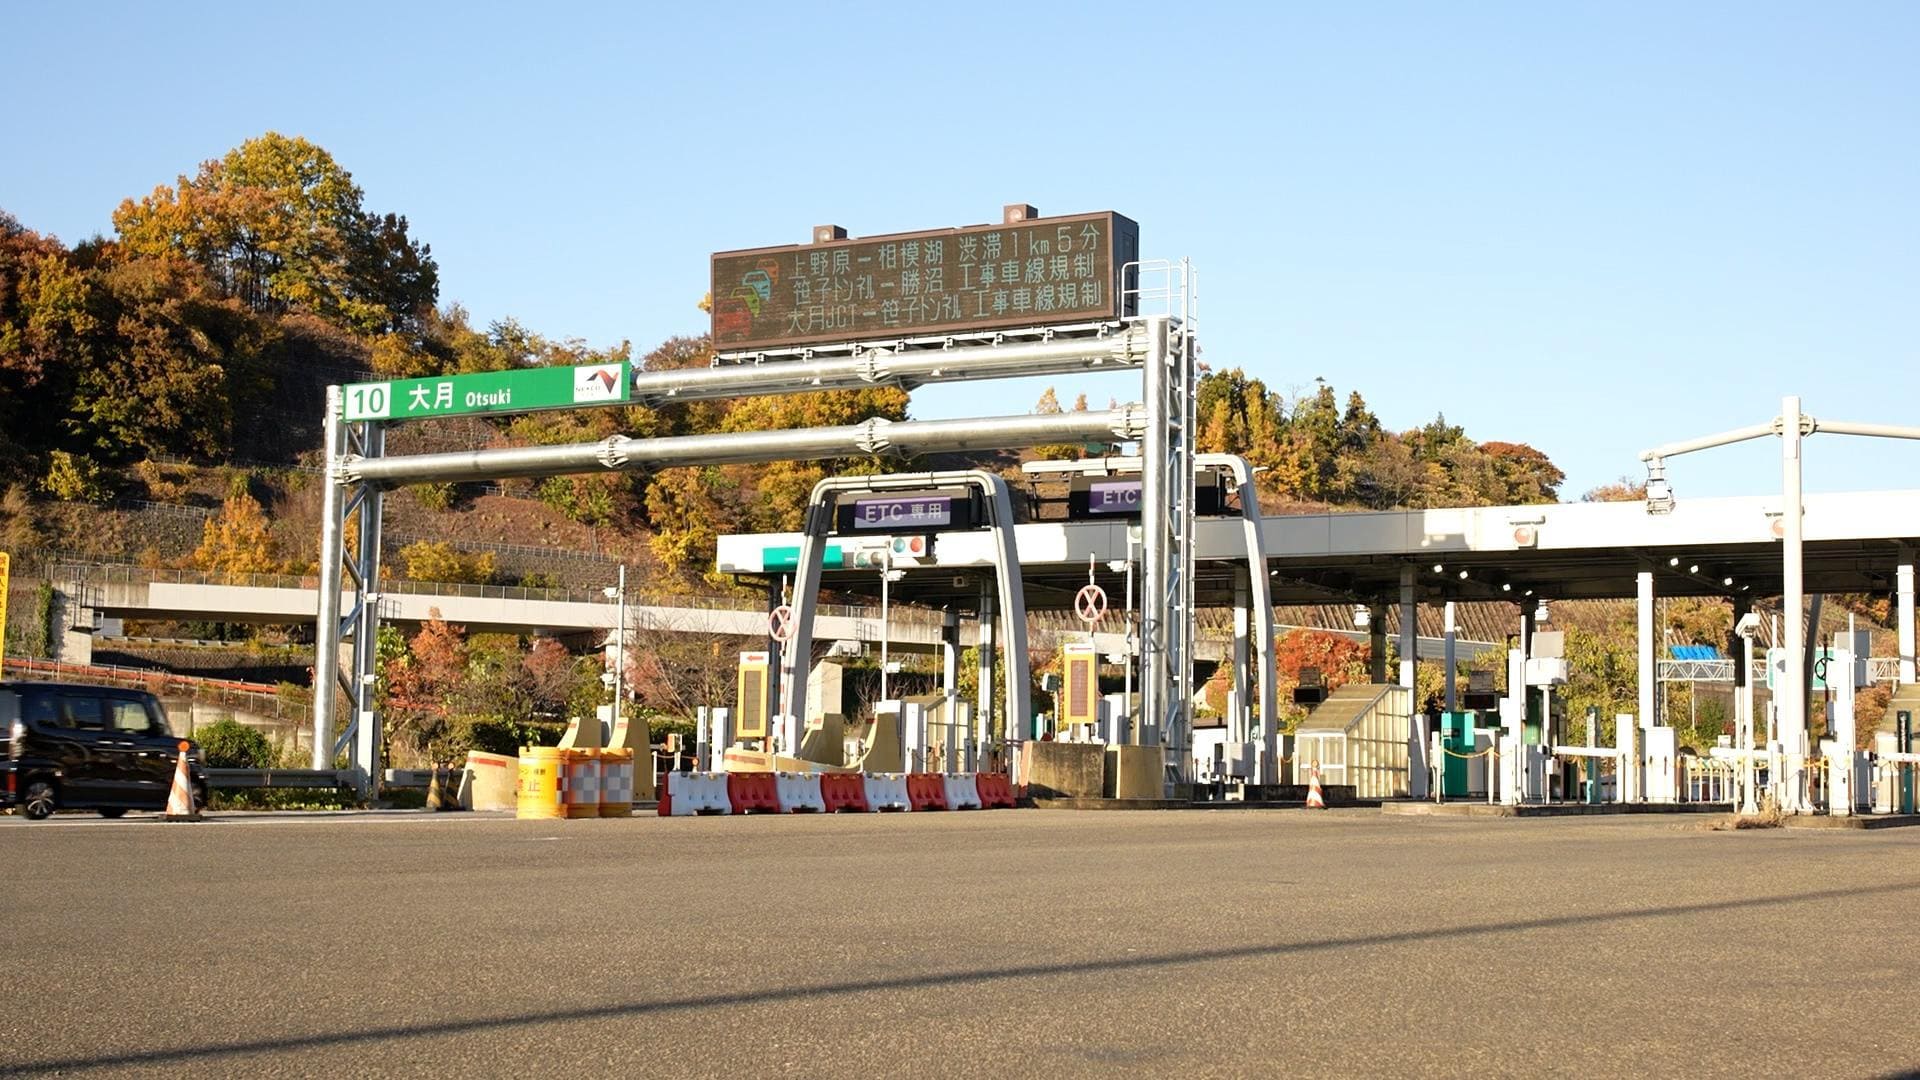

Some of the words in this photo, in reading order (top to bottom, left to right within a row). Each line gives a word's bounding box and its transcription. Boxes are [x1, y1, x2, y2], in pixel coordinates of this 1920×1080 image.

[958, 252, 1095, 291] 工事車線規制
[973, 279, 1102, 318] 工事車線規制
[353, 387, 385, 414] 10
[408, 381, 454, 411] 大月
[465, 388, 511, 407] Otsuki
[865, 504, 903, 521] ETC
[911, 503, 942, 519] 専用
[1103, 488, 1137, 505] ETC
